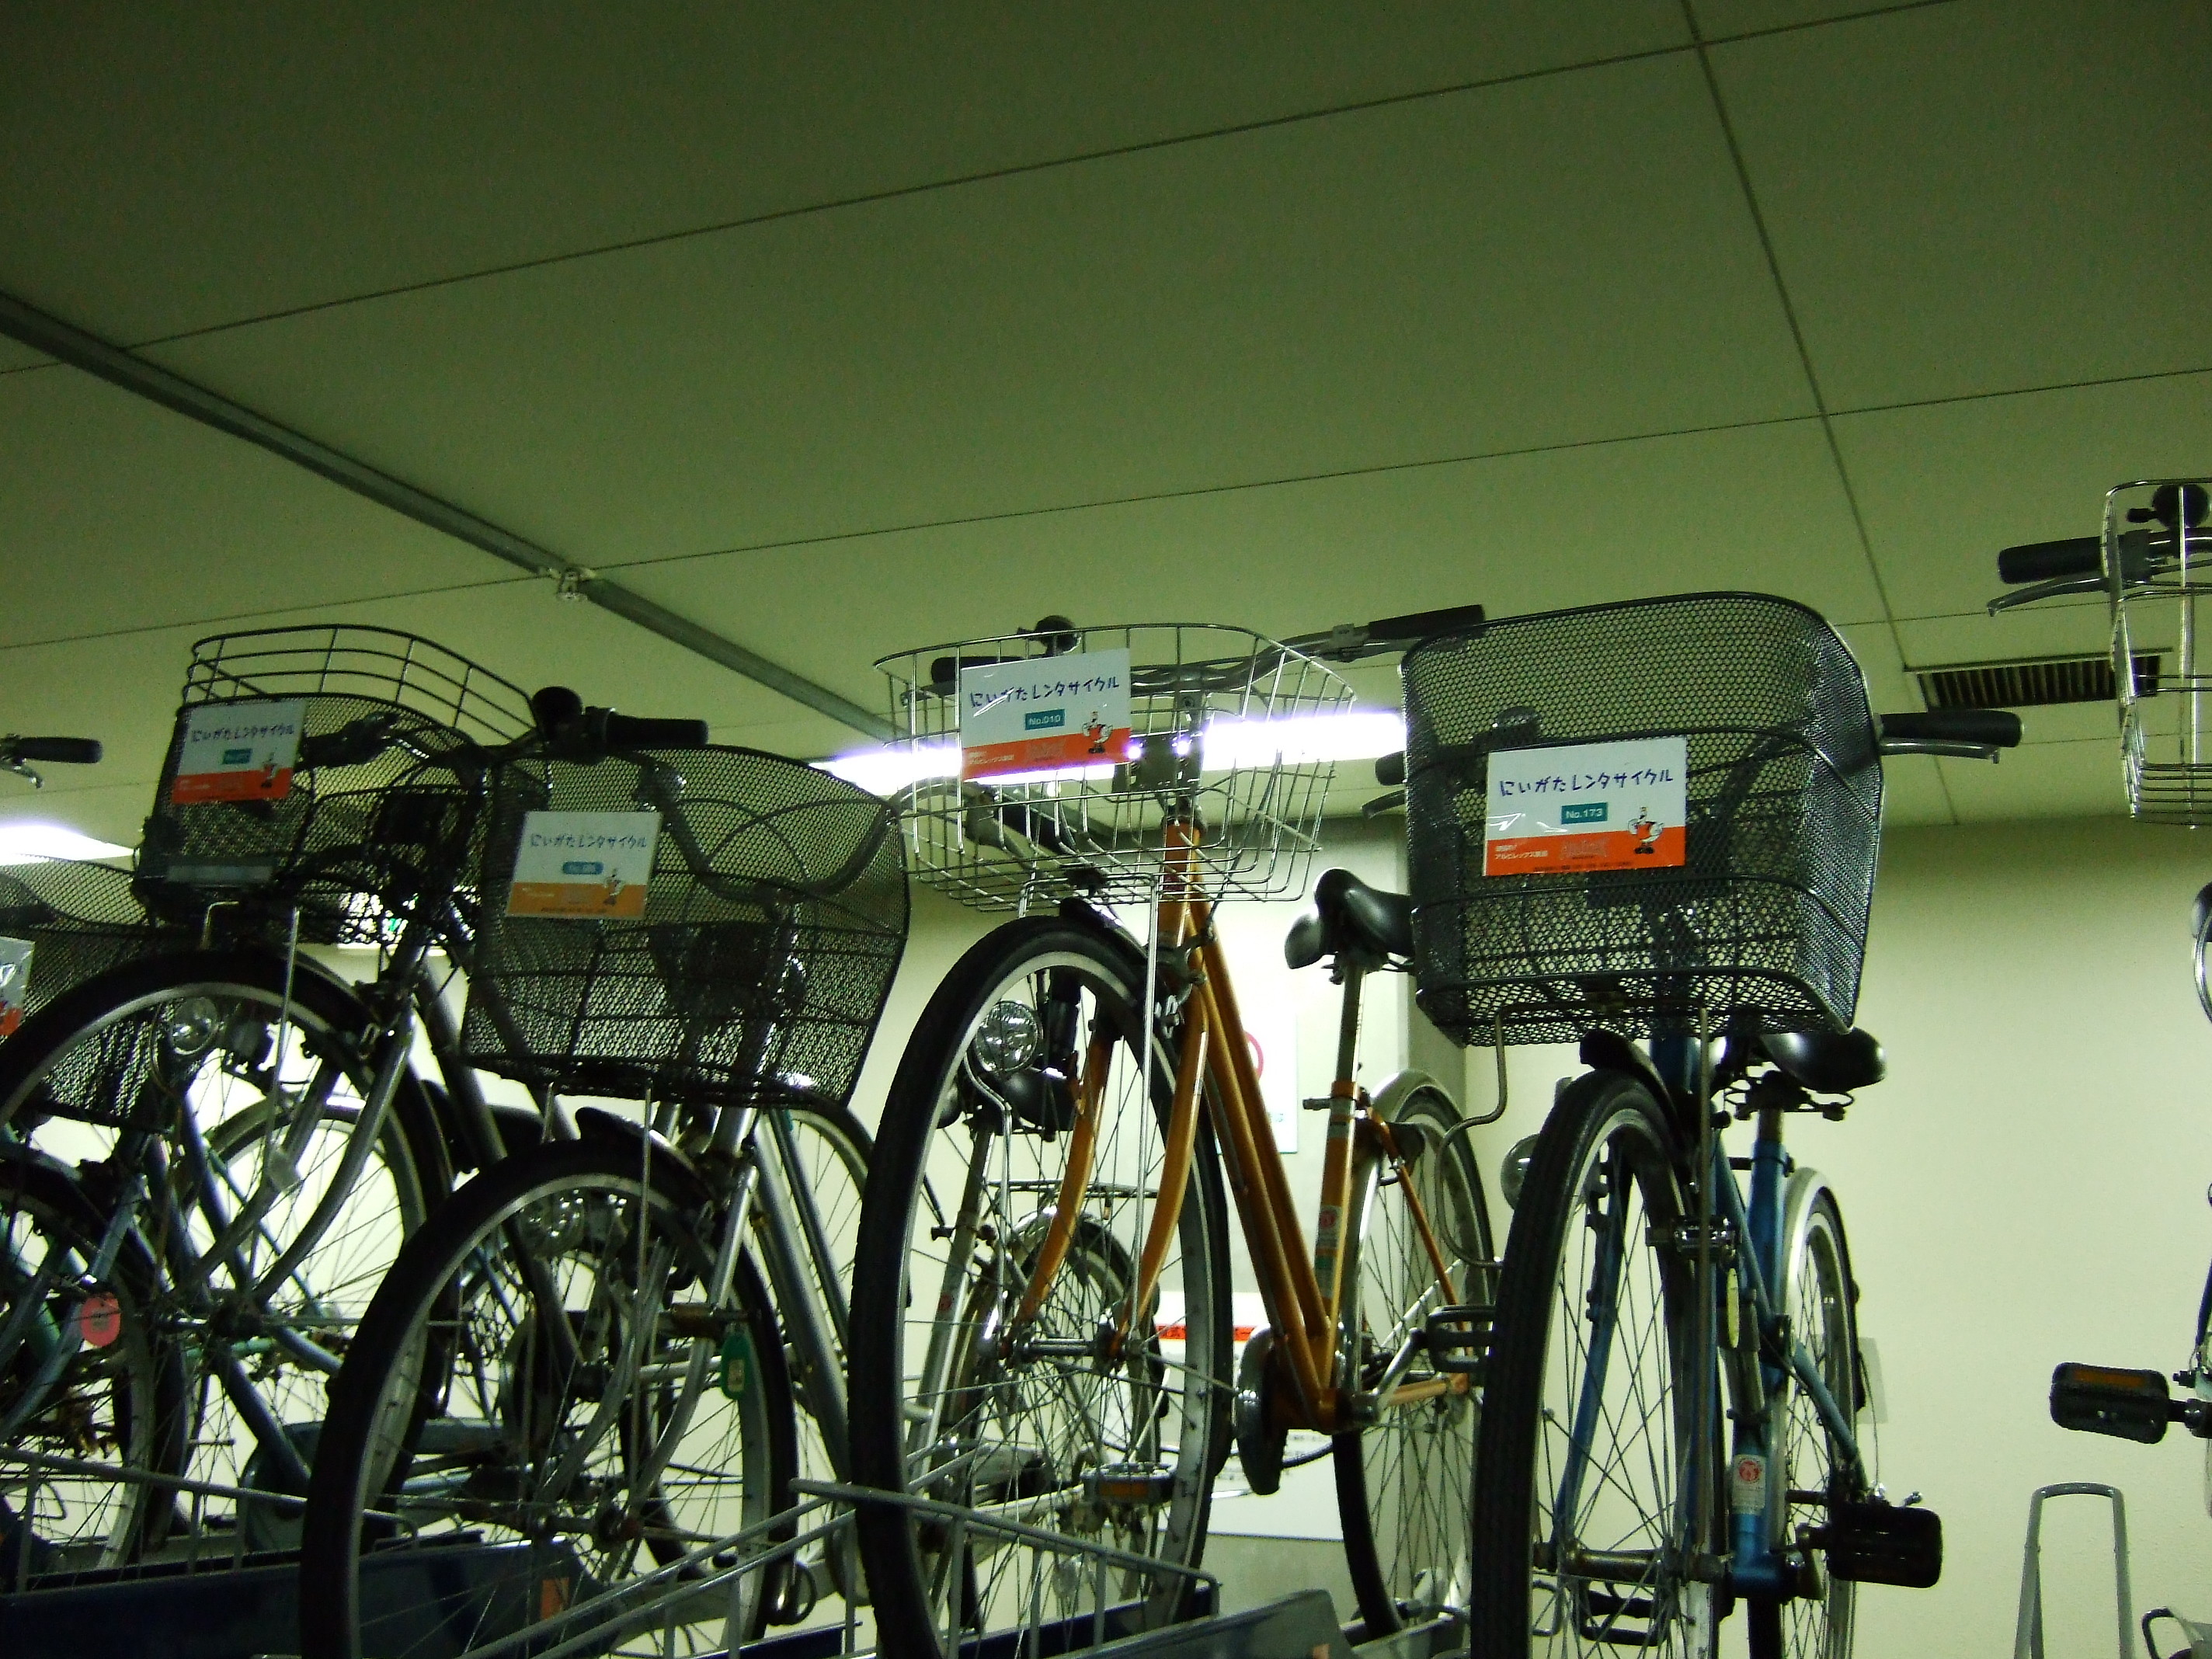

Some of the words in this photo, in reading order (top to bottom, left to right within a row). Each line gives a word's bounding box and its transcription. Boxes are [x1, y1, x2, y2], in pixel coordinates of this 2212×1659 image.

[970, 676, 1120, 708] にいがたレンタサイクル
[1028, 715, 1061, 725] No.010
[1499, 768, 1674, 797] にいがたレンタサイクル
[1566, 808, 1602, 819] No.173
[530, 833, 648, 849] にいがたレンタサイクル
